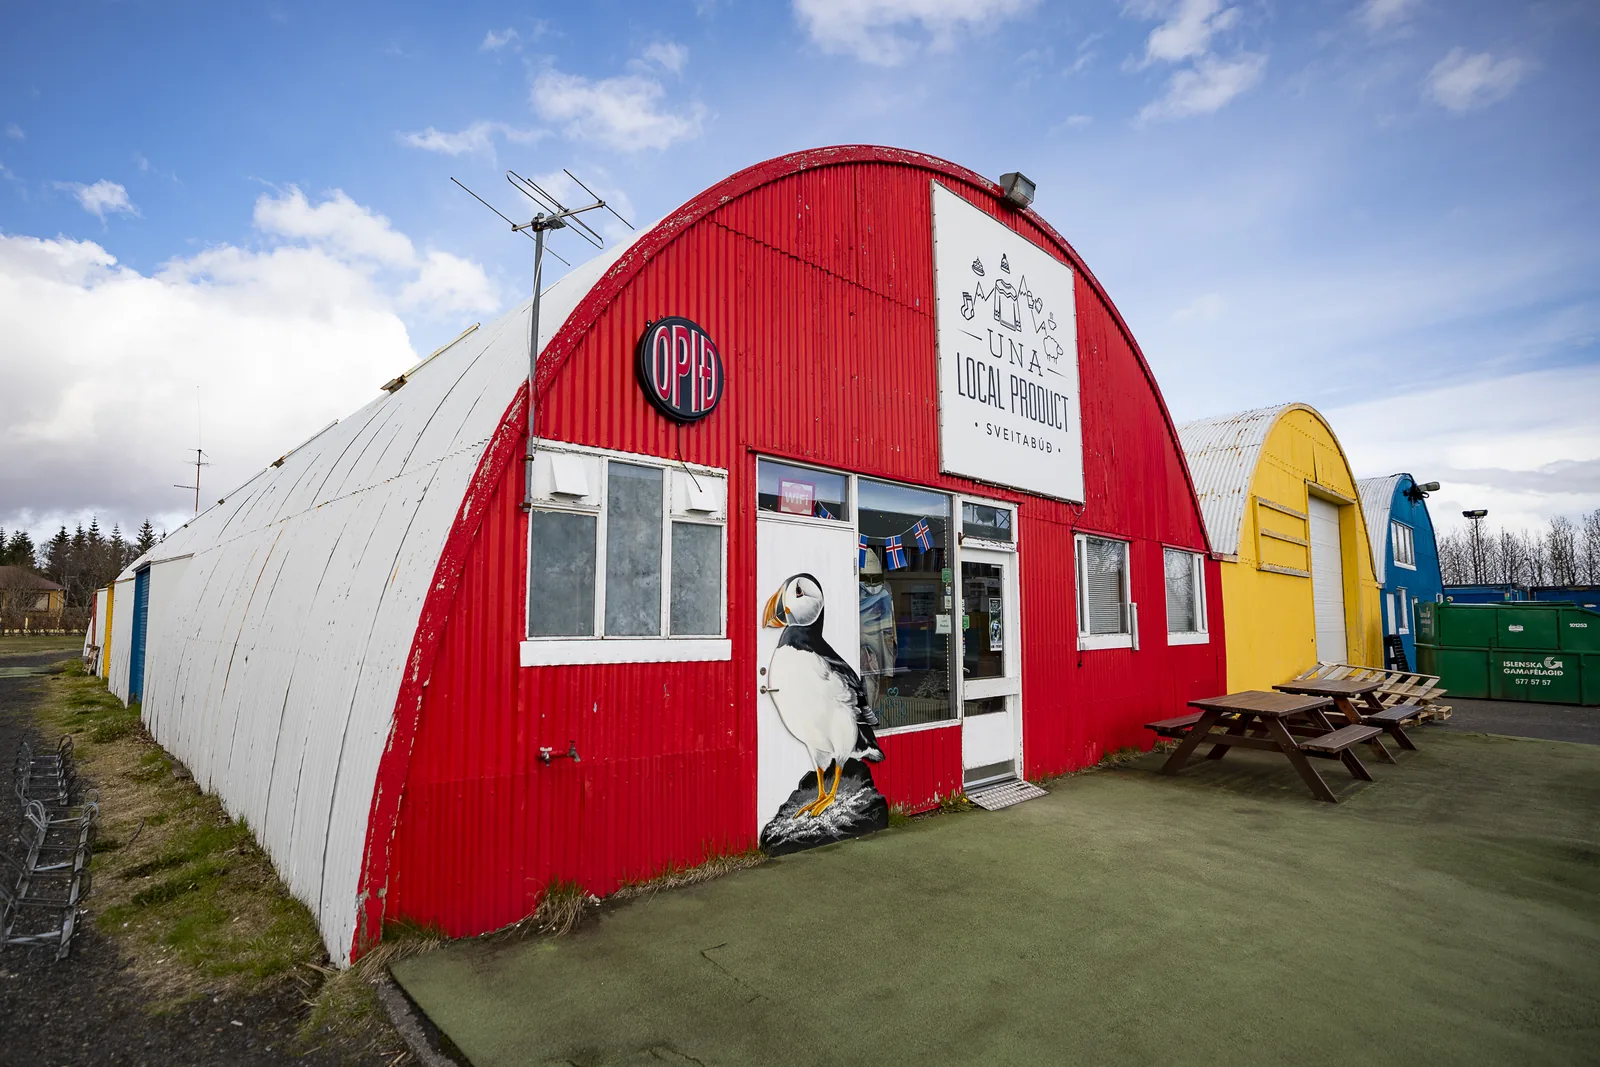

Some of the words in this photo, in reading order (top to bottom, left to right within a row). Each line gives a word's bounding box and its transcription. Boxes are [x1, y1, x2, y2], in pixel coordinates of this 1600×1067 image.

[987, 328, 1044, 377] UNA
[956, 351, 1006, 410] LOCAL
[1010, 373, 1069, 433] PRODUCT
[1530, 678, 1541, 686] 57
